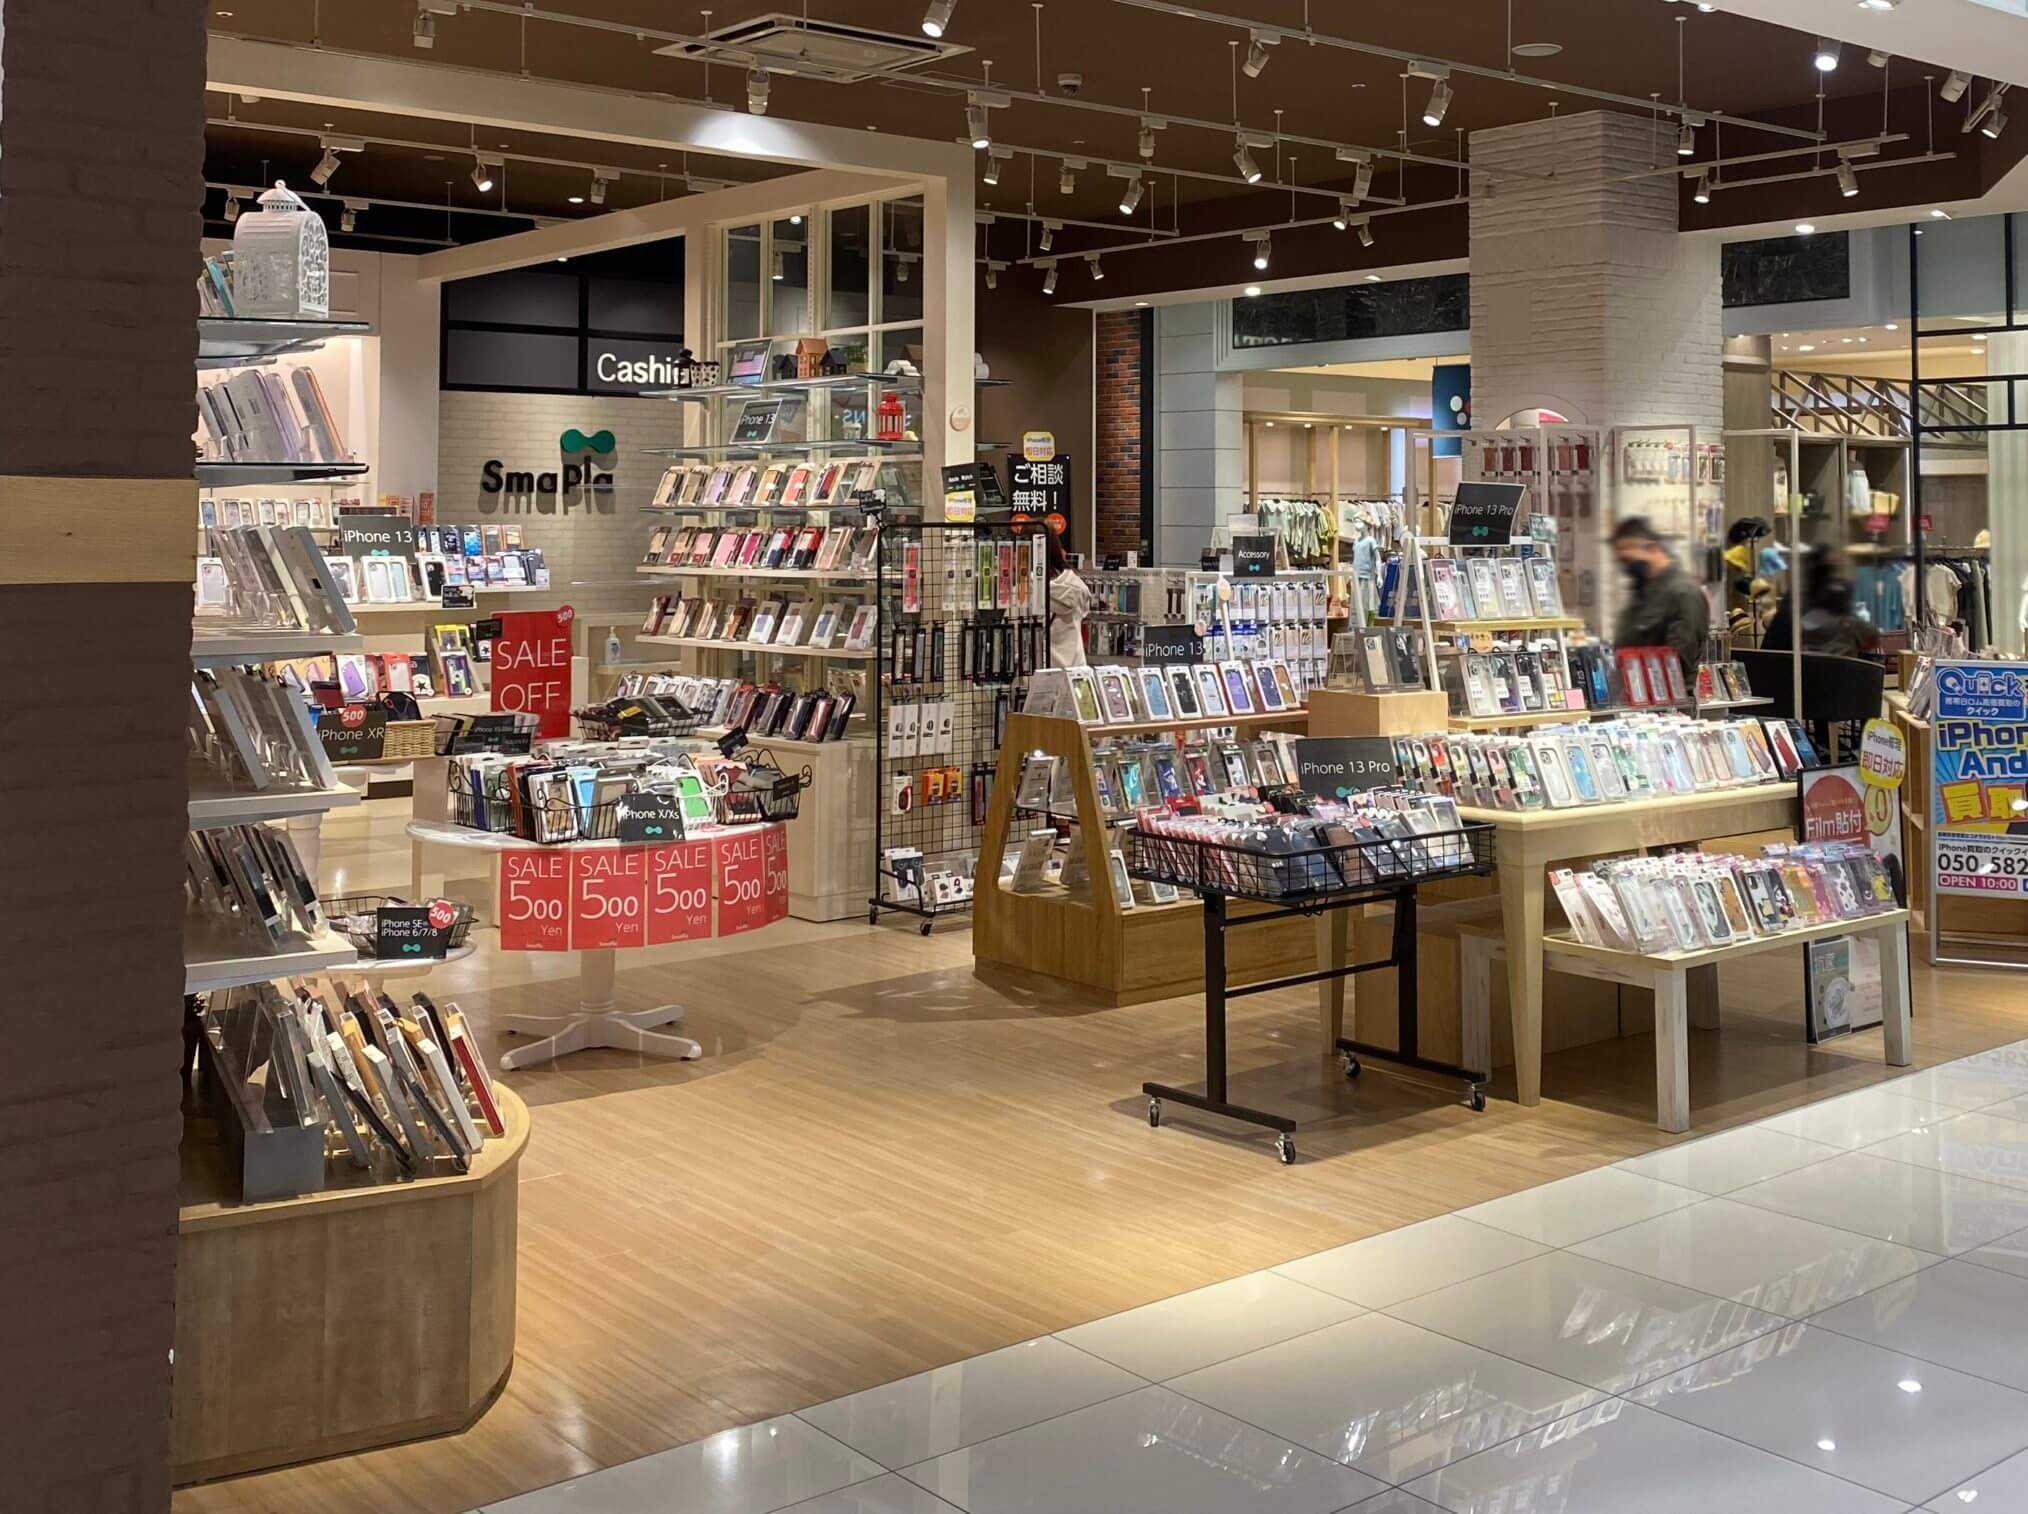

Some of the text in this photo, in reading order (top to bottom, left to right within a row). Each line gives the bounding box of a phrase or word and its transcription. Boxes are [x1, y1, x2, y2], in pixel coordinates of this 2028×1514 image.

[481, 455, 614, 494] SmaPla
[1014, 463, 1063, 485] ご相談
[1455, 504, 1514, 516] iPhone 13 Pro
[343, 530, 413, 544] iPhone 13
[1238, 550, 1270, 561] Accessory
[496, 638, 567, 670] SALE
[1144, 642, 1203, 657] iPhone 13
[1936, 667, 2024, 697] Quick
[500, 681, 561, 712] OFF
[343, 710, 364, 722] 500
[1967, 706, 1999, 716] クイック
[319, 727, 384, 741] iPhone XR
[1301, 760, 1391, 775] iPhone 13 Pro
[659, 810, 679, 820] X/Xs
[766, 831, 785, 855] SALE
[721, 838, 759, 865] SALE
[507, 856, 563, 878] SALE
[579, 854, 639, 877] SALE
[654, 847, 707, 872] SALE
[766, 856, 787, 895] 500
[1940, 875, 2017, 889] OPEN 10:00
[724, 864, 760, 905] 500
[508, 880, 562, 920] 500
[580, 879, 638, 920] 500
[655, 873, 706, 914] 500
[429, 907, 451, 923] 500
[746, 904, 761, 915] Yen
[382, 919, 411, 928] iPhone
[686, 914, 706, 925] Yen
[382, 928, 438, 937] iPhone 6/7/8
[540, 924, 562, 936] Yen
[616, 921, 638, 934] Yen
